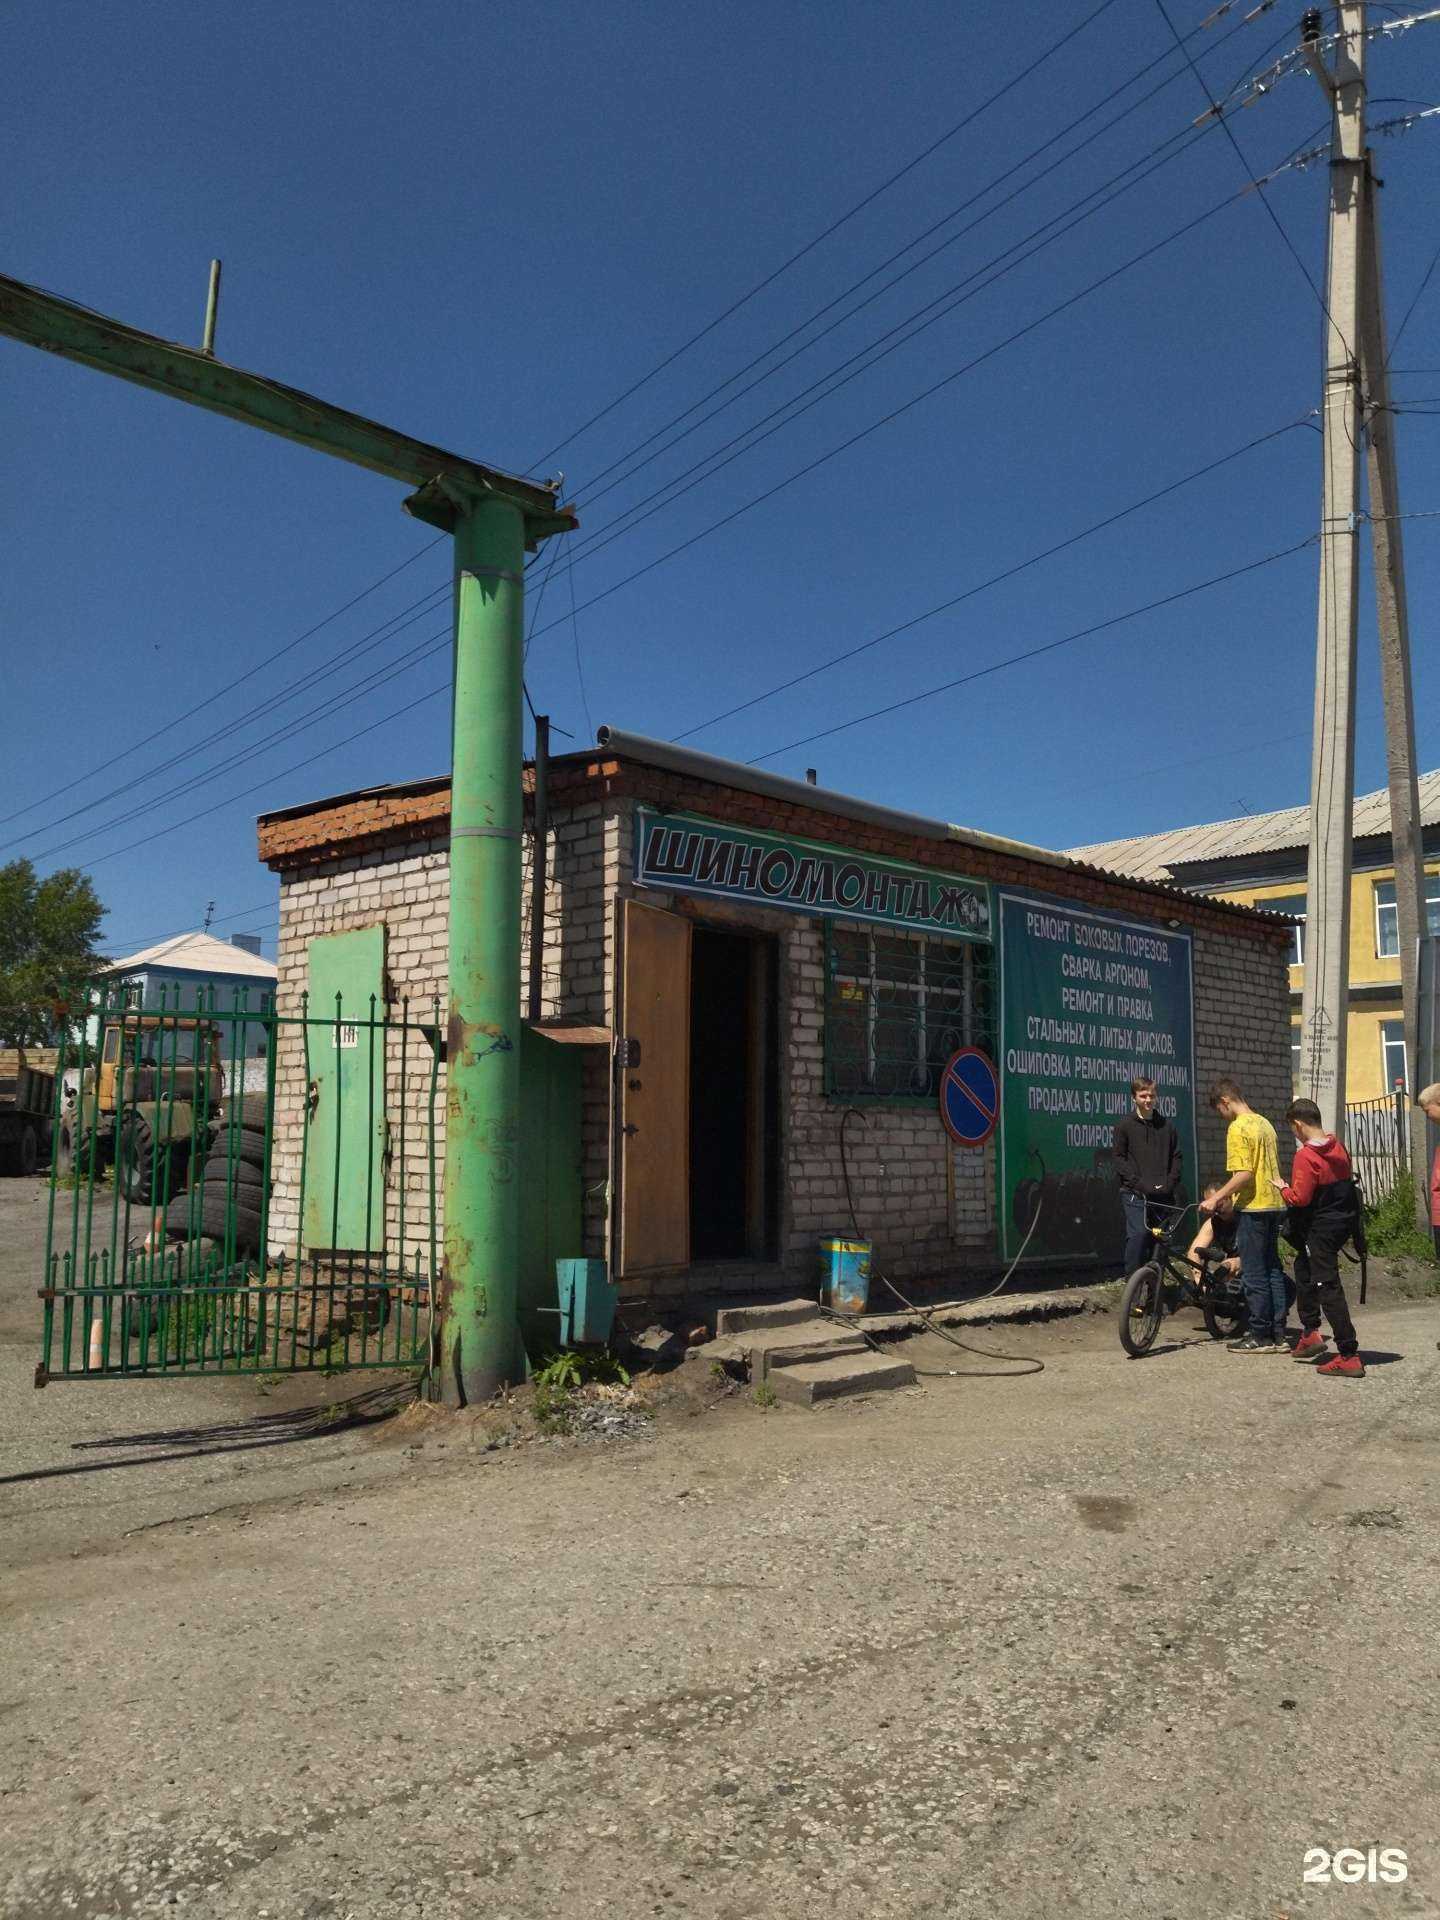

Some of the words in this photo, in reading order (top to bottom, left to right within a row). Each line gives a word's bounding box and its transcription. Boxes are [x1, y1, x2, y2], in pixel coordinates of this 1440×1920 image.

[643, 826, 971, 928] ШИНОМОНТАЖ
[1026, 912, 1071, 943] РЕМОНТ
[1074, 924, 1123, 953] БОКОВЫХ
[1126, 934, 1172, 967] ПОРЕЗОВ,
[1061, 953, 1101, 981] СВАРКА
[1105, 962, 1152, 993] АРГОНОМ,
[1062, 987, 1105, 1014] РЕМОНТ
[1107, 994, 1114, 1015] И
[1117, 996, 1154, 1022] ПРАВКА
[1027, 1015, 1086, 1045] СТАЛЬНЫХ
[1089, 1025, 1096, 1045] И
[1100, 1026, 1133, 1050] ЛИТЫХ
[1135, 1031, 1176, 1059] ДИСКОВ,
[1007, 1048, 1071, 1078] ОШИПОВКА
[1074, 1056, 1144, 1082] РЕМОНТНЫМИ
[1028, 1086, 1081, 1116] ПРОДАЖА
[1084, 1091, 1100, 1117] Б/У
[1104, 1092, 1127, 1115] ШИН
